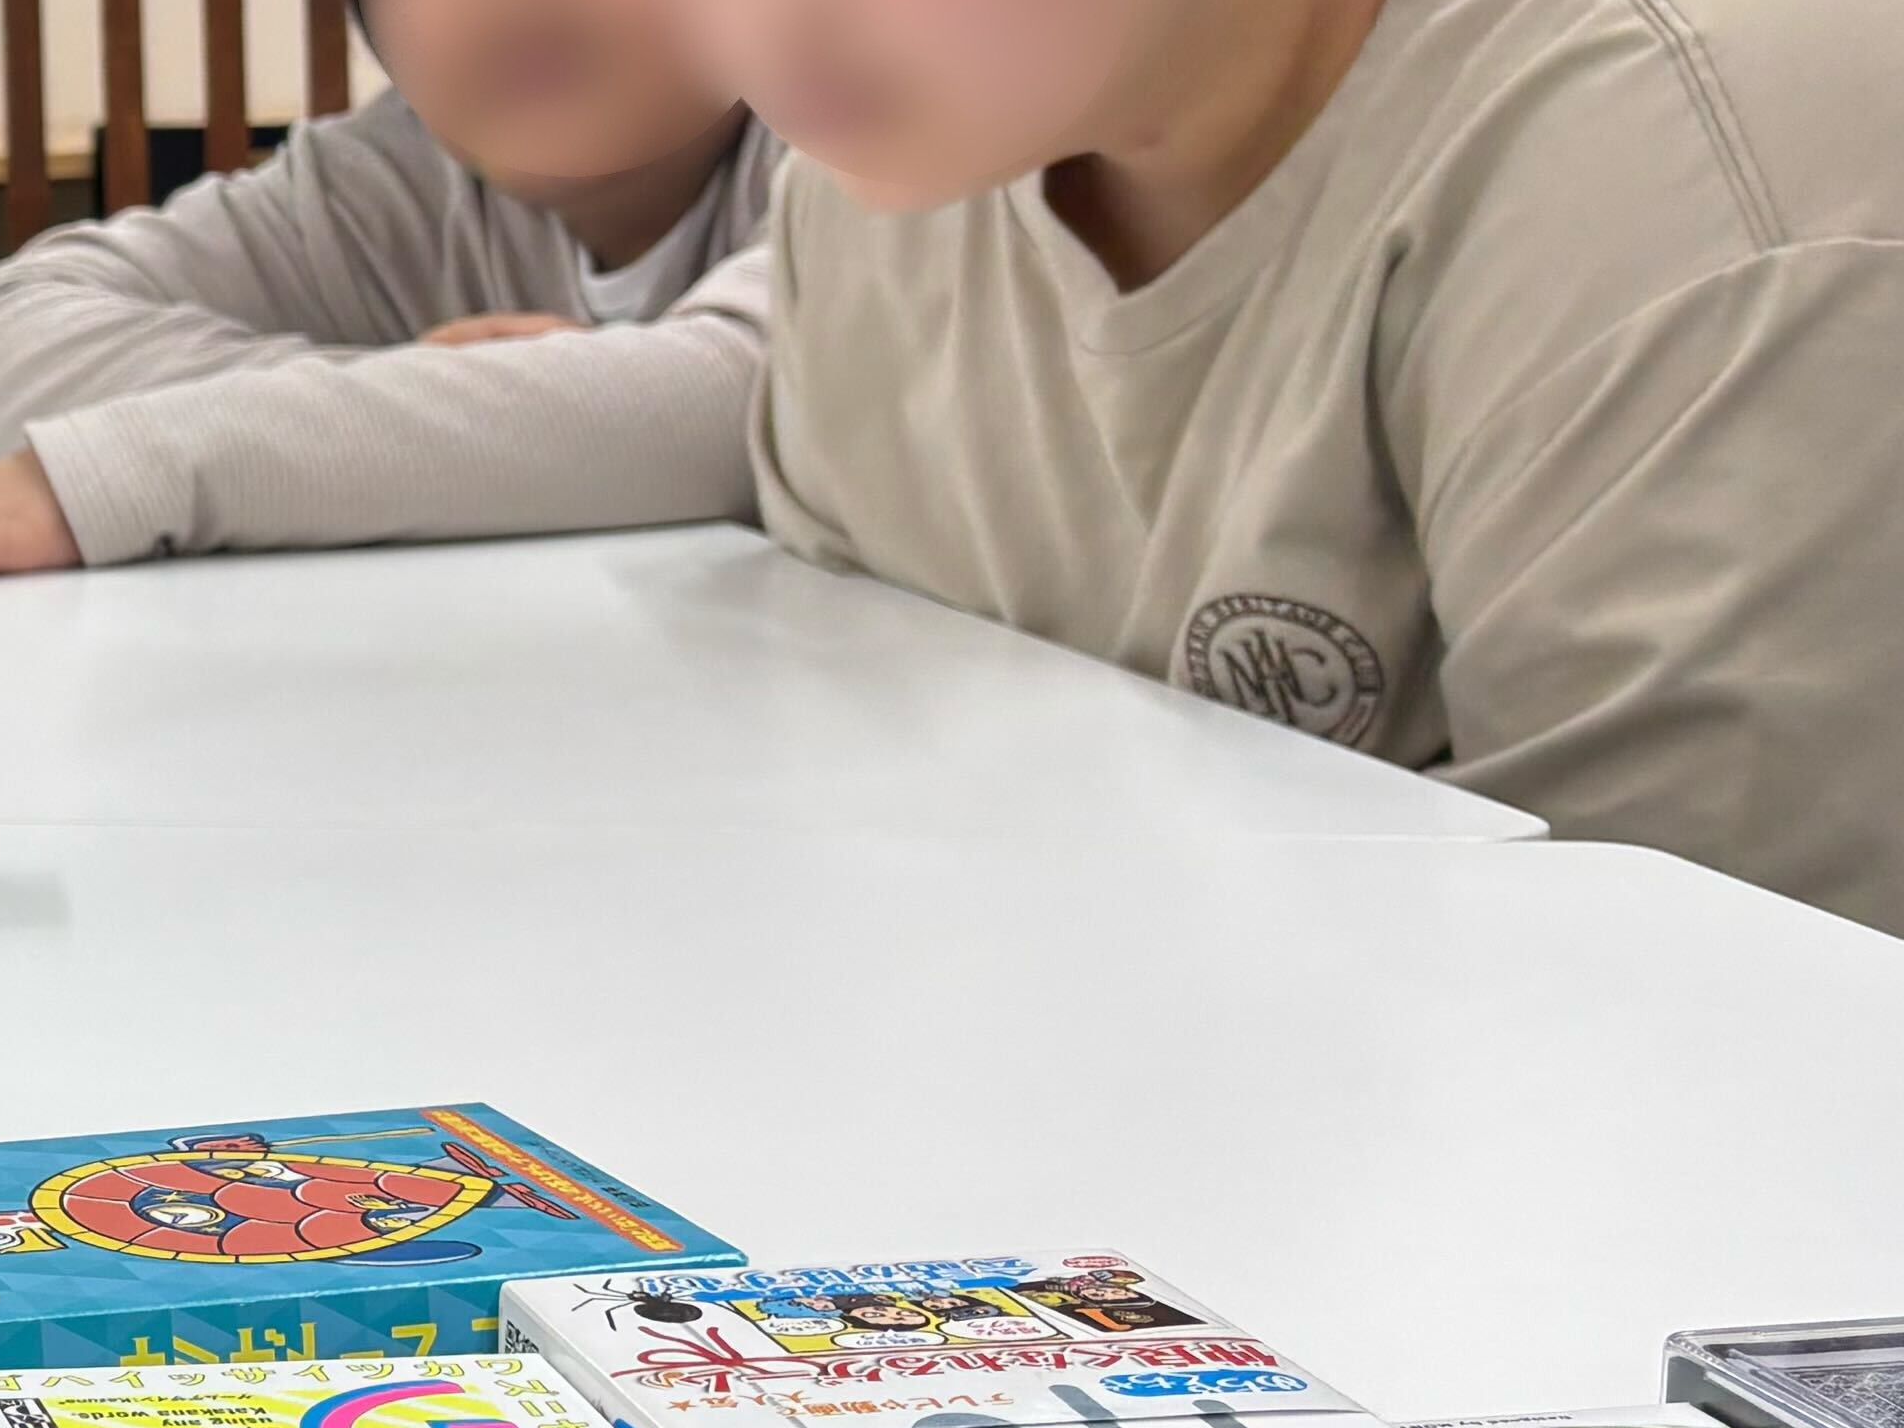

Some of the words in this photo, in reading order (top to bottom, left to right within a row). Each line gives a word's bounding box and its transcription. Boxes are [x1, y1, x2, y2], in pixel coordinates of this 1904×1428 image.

[777, 1390, 1015, 1418] テレビや動画で
[158, 1406, 268, 1416] Katakana
[162, 1417, 201, 1427] any
[210, 1416, 274, 1425] using
